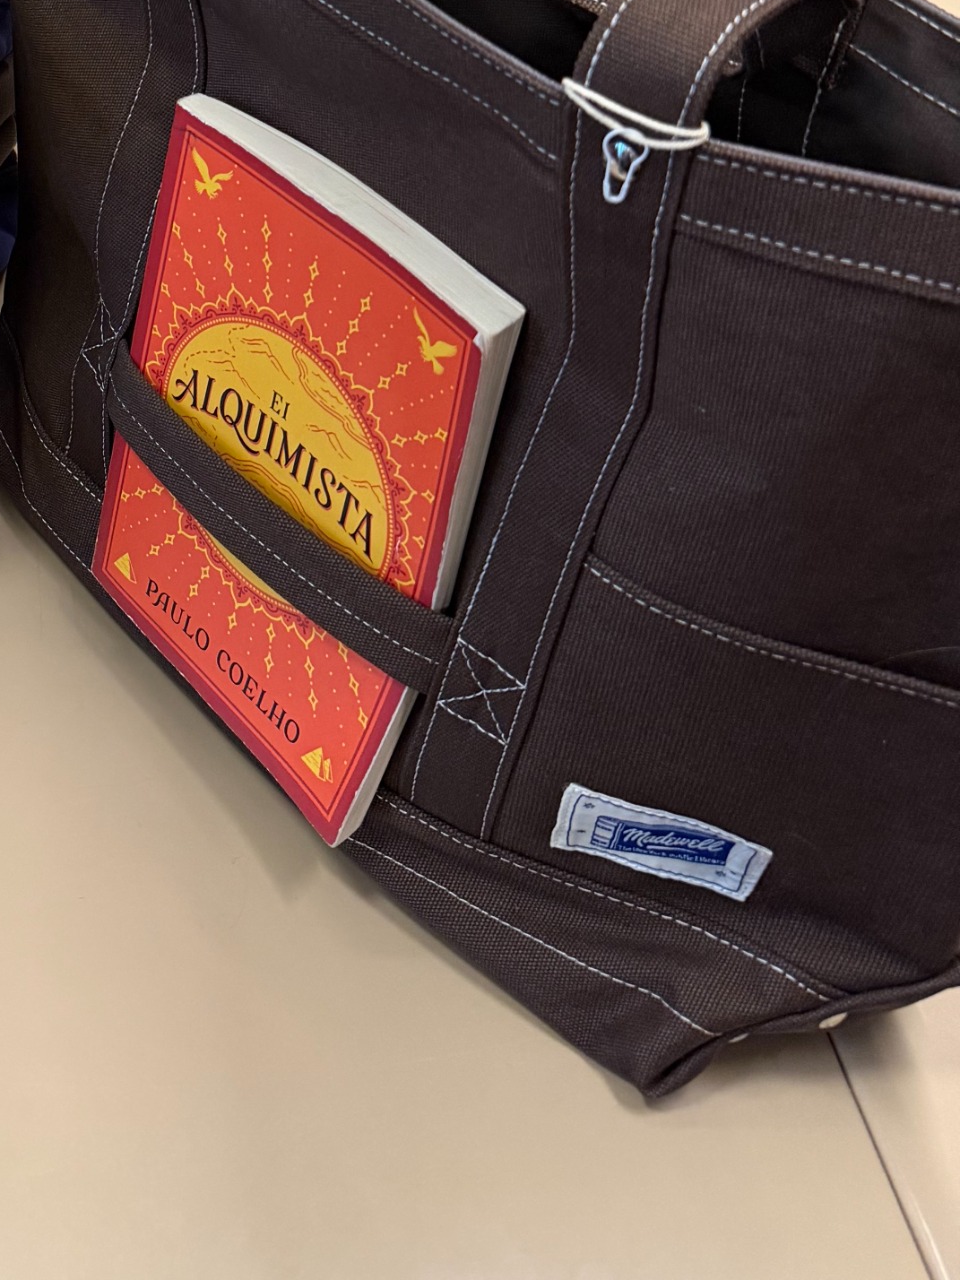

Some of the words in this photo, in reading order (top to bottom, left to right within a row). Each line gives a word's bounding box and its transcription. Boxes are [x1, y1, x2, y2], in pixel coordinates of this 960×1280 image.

[172, 368, 375, 565] ALQUIMISTA
[144, 576, 211, 652] PAULO
[215, 647, 302, 744] COELHO
[622, 827, 726, 852] Madewell
